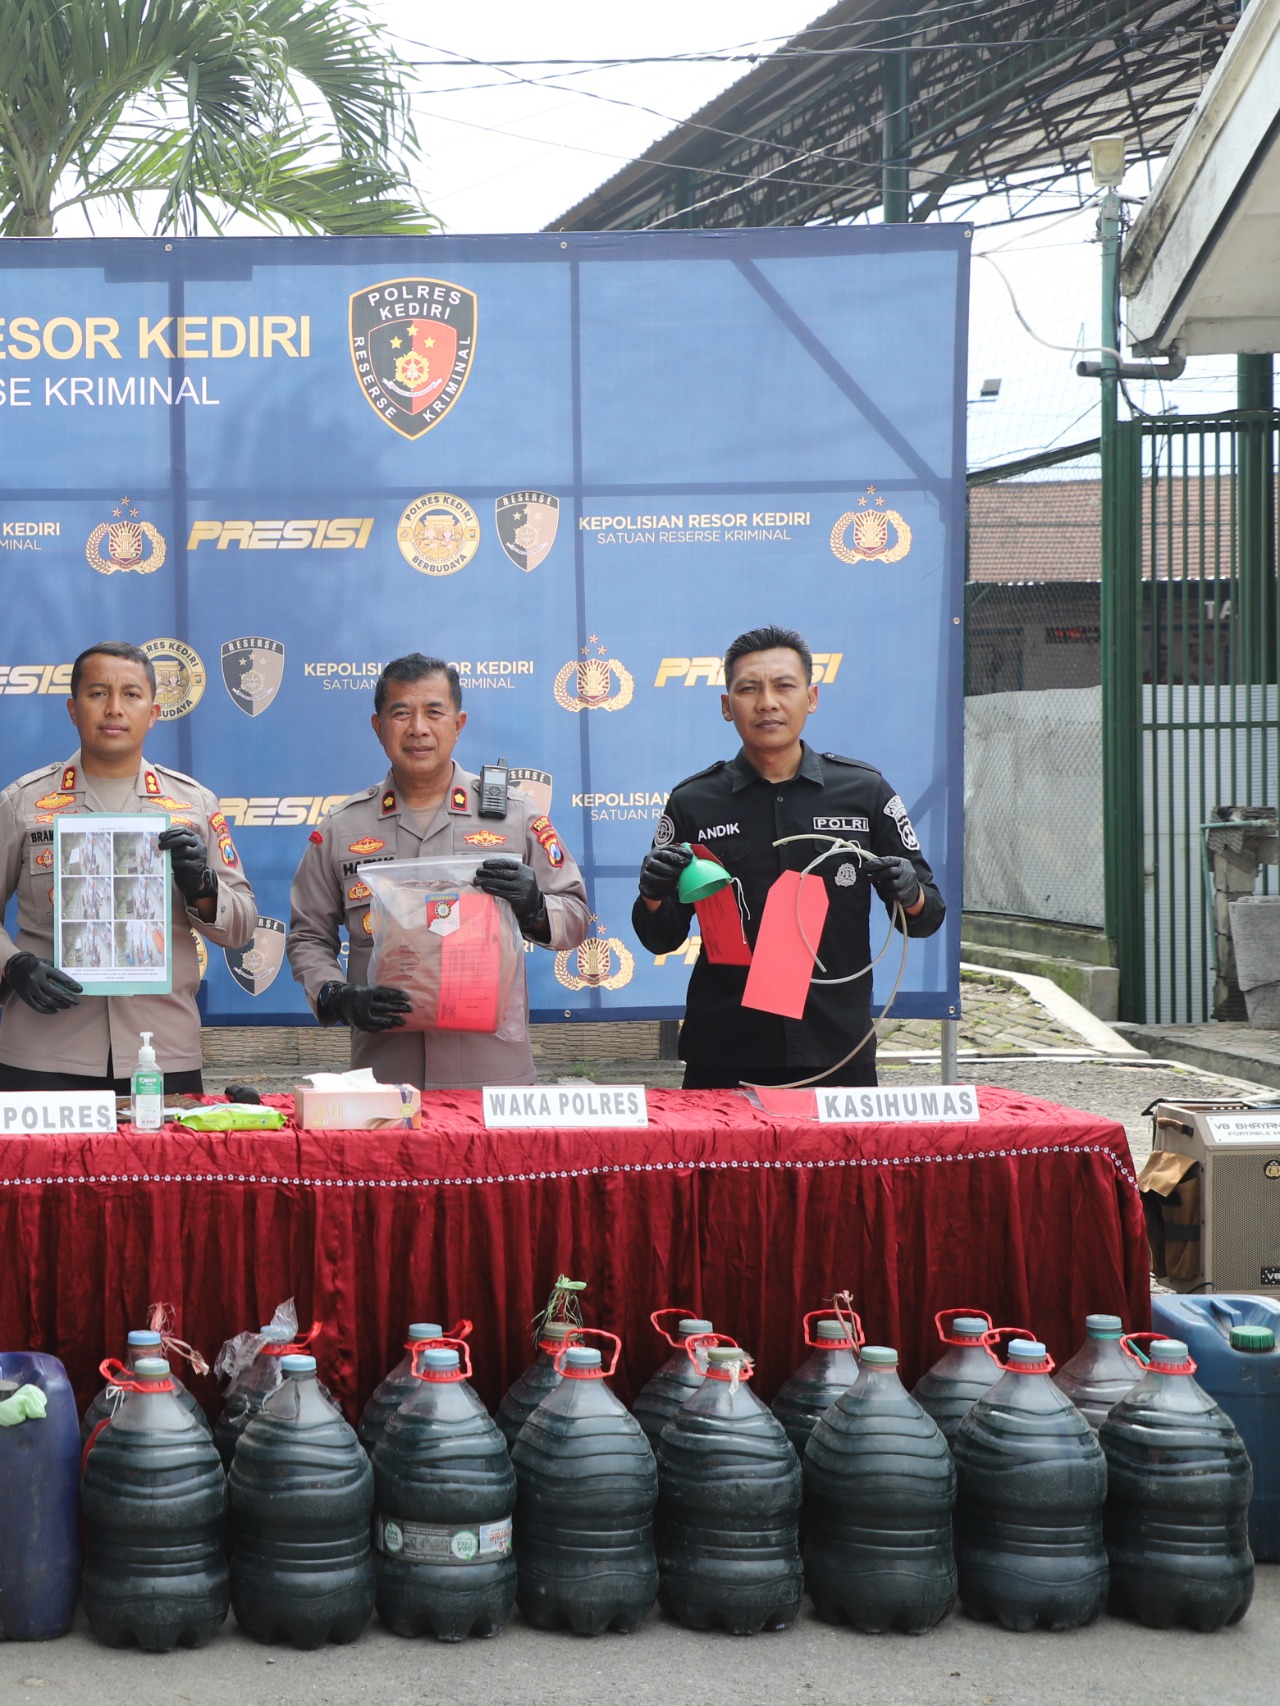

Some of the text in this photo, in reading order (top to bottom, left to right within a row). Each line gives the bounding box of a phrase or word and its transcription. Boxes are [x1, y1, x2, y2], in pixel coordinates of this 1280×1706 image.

[368, 285, 462, 306] POLRES
[379, 303, 450, 320] KEDIRI
[139, 315, 310, 359] KEDIRI
[353, 336, 397, 419] RESERSE
[422, 335, 471, 422] KRIMINAL
[45, 376, 220, 406] KRIMINAL
[503, 492, 552, 506] RESERSE
[404, 495, 473, 522] POLRES KEDIRI
[2, 522, 60, 536] KEDIRI
[578, 512, 811, 530] KEPOLISIAN RESOR KEDIRI
[185, 518, 375, 550] PRESISI
[597, 528, 791, 544] SATUAN RESERSE KRIMINAL
[411, 554, 467, 573] BERBUDAYA
[227, 638, 278, 652] RESERSE
[168, 642, 200, 668] KEDIRI
[304, 662, 386, 677] KEPOLISI
[476, 660, 534, 675] KEDIRI
[459, 677, 516, 689] RIMINAL
[510, 769, 546, 783] SERSE
[591, 808, 644, 821] SATUAN
[698, 822, 740, 842] ANDIK
[816, 818, 868, 830] POLRI
[489, 1091, 639, 1117] WAKA POLRES
[824, 1091, 974, 1118] KASIHUMAS
